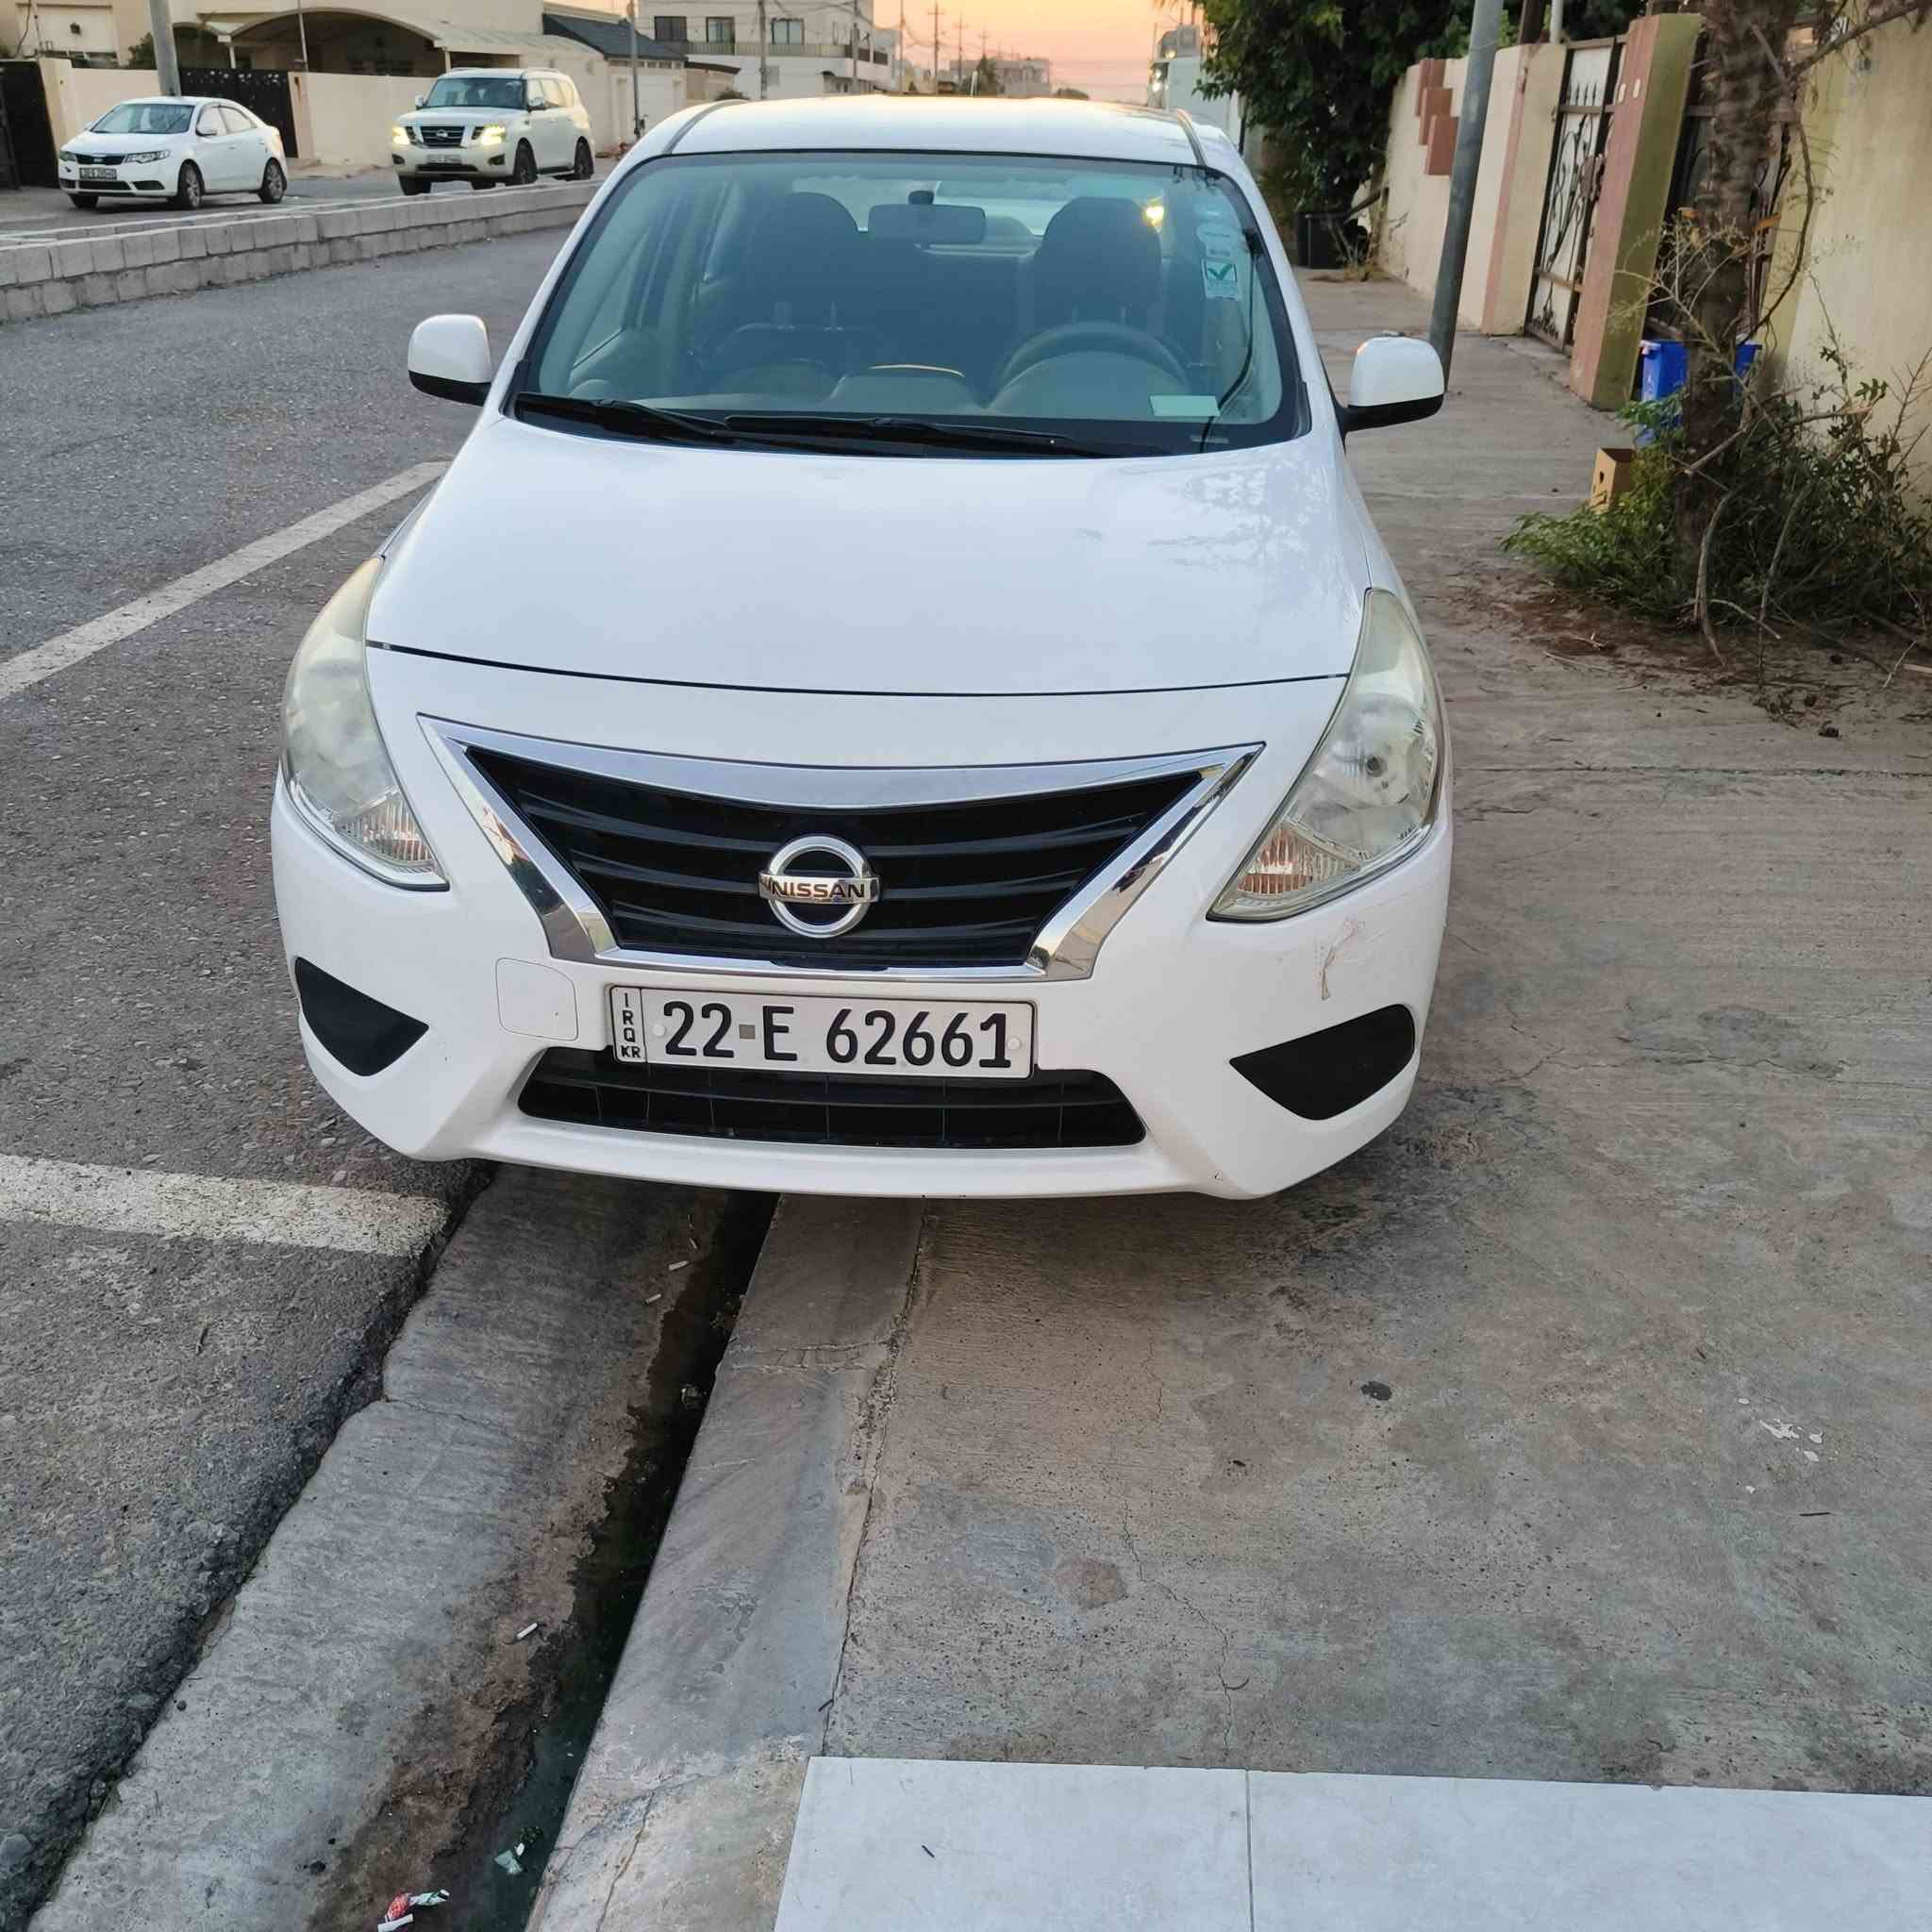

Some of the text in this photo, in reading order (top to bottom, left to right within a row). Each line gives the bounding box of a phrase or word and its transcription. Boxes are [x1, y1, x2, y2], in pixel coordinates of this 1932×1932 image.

[771, 880, 866, 899] NISSAN
[662, 1000, 1012, 1069] 22 E 62661
[621, 1044, 641, 1058] KR
